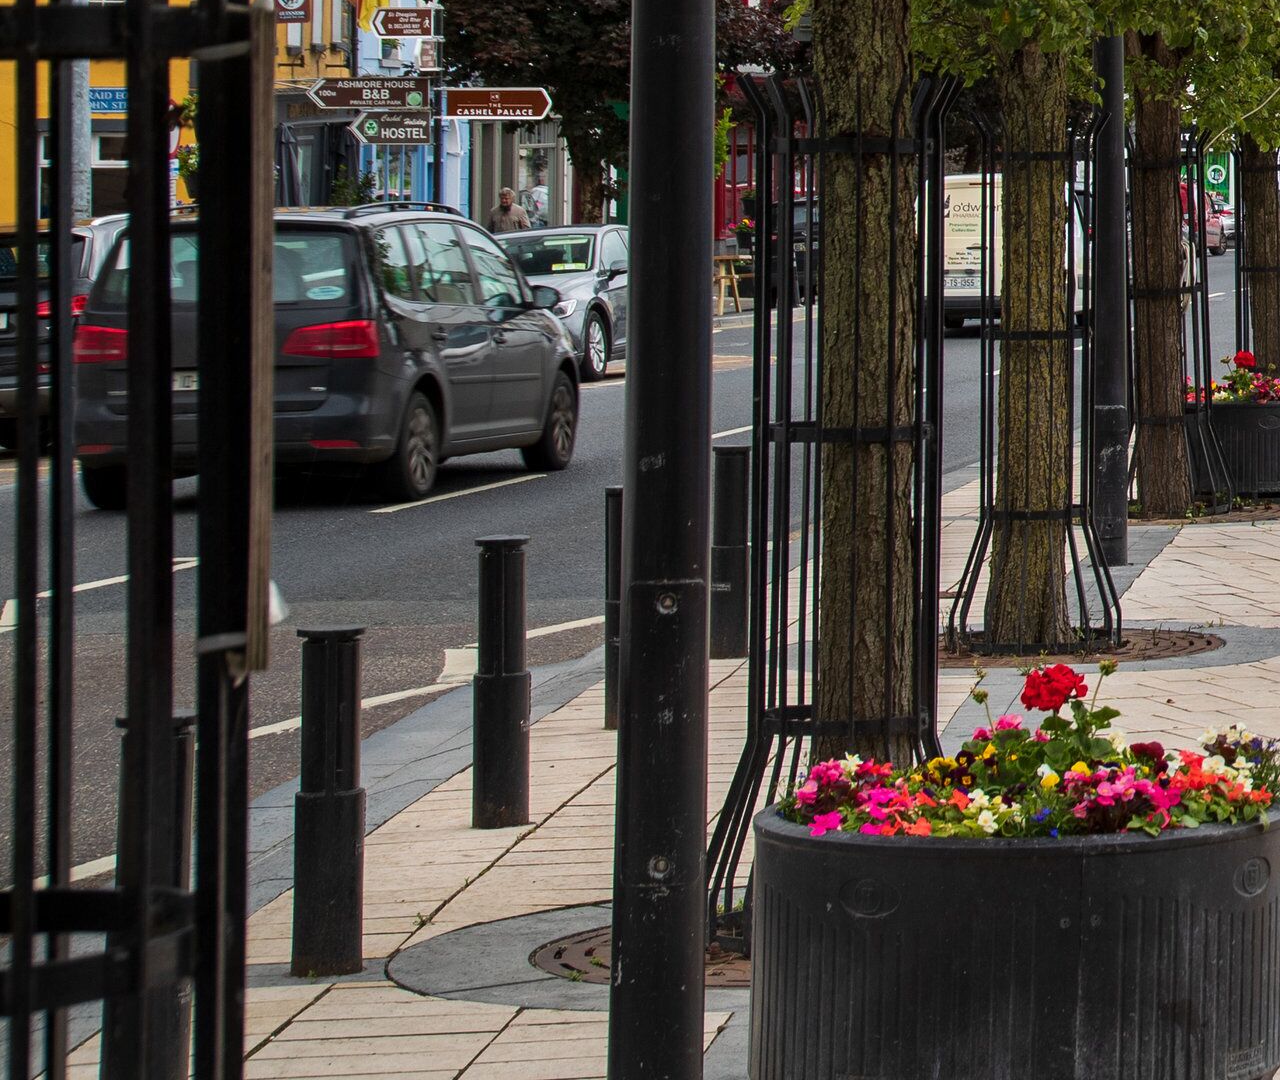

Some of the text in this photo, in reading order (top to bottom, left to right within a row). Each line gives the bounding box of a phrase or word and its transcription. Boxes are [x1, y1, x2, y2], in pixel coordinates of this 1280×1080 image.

[337, 80, 416, 88] ASHMORE HOUSE
[362, 89, 390, 100] B&B
[456, 108, 533, 116] CASHEL PALACE
[381, 127, 427, 139] HOSTEL
